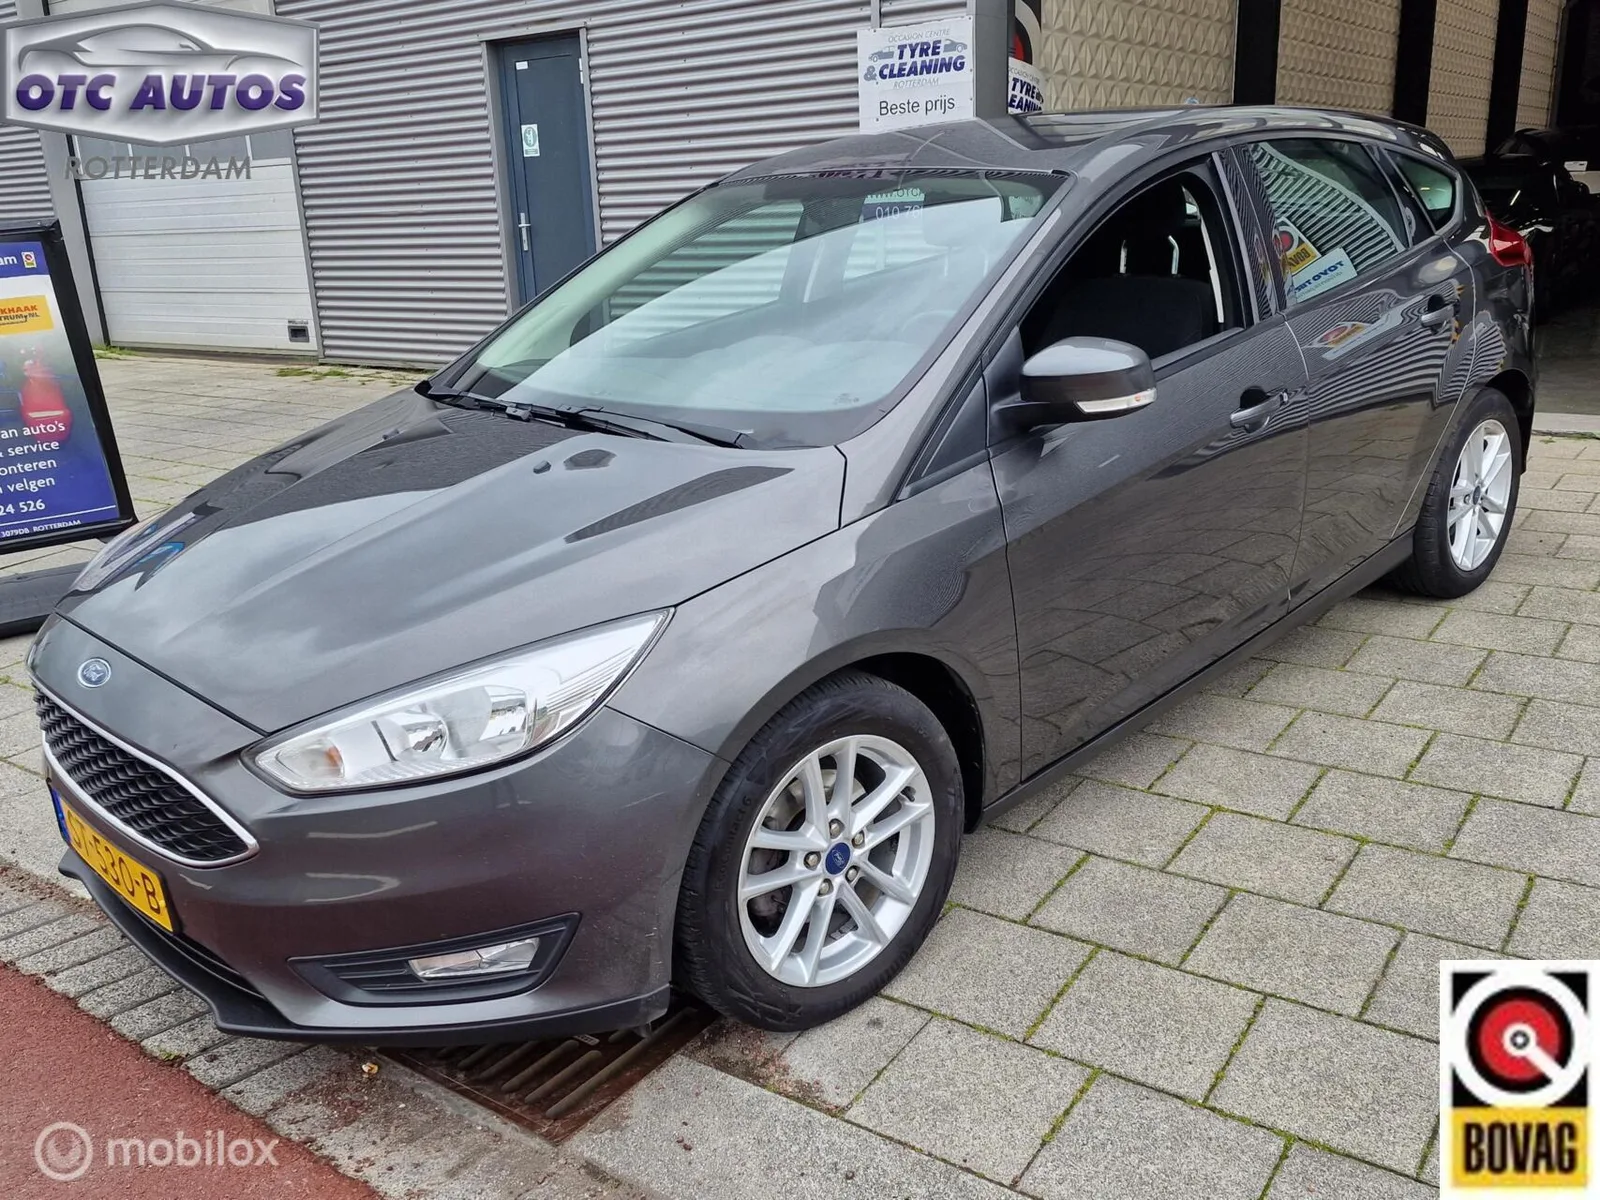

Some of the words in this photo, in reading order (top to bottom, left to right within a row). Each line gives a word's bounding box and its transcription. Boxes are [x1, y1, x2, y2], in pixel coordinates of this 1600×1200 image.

[888, 32, 922, 43] OCCASION
[925, 28, 950, 39] CENTRE
[897, 40, 942, 60] TYRE
[863, 65, 877, 81] &
[878, 55, 966, 80] CLEANING
[893, 77, 939, 89] ROTTERDAM
[1011, 77, 1037, 99] TYRE
[879, 99, 920, 116] Beste
[925, 94, 955, 116] prijs
[23, 421, 66, 436] auto's
[8, 440, 60, 457] service
[0, 459, 57, 476] onteren
[7, 477, 56, 492] velgen
[19, 499, 46, 513] 526
[33, 519, 82, 533] ROTTERDAM
[67, 810, 161, 915] ST-530-B
